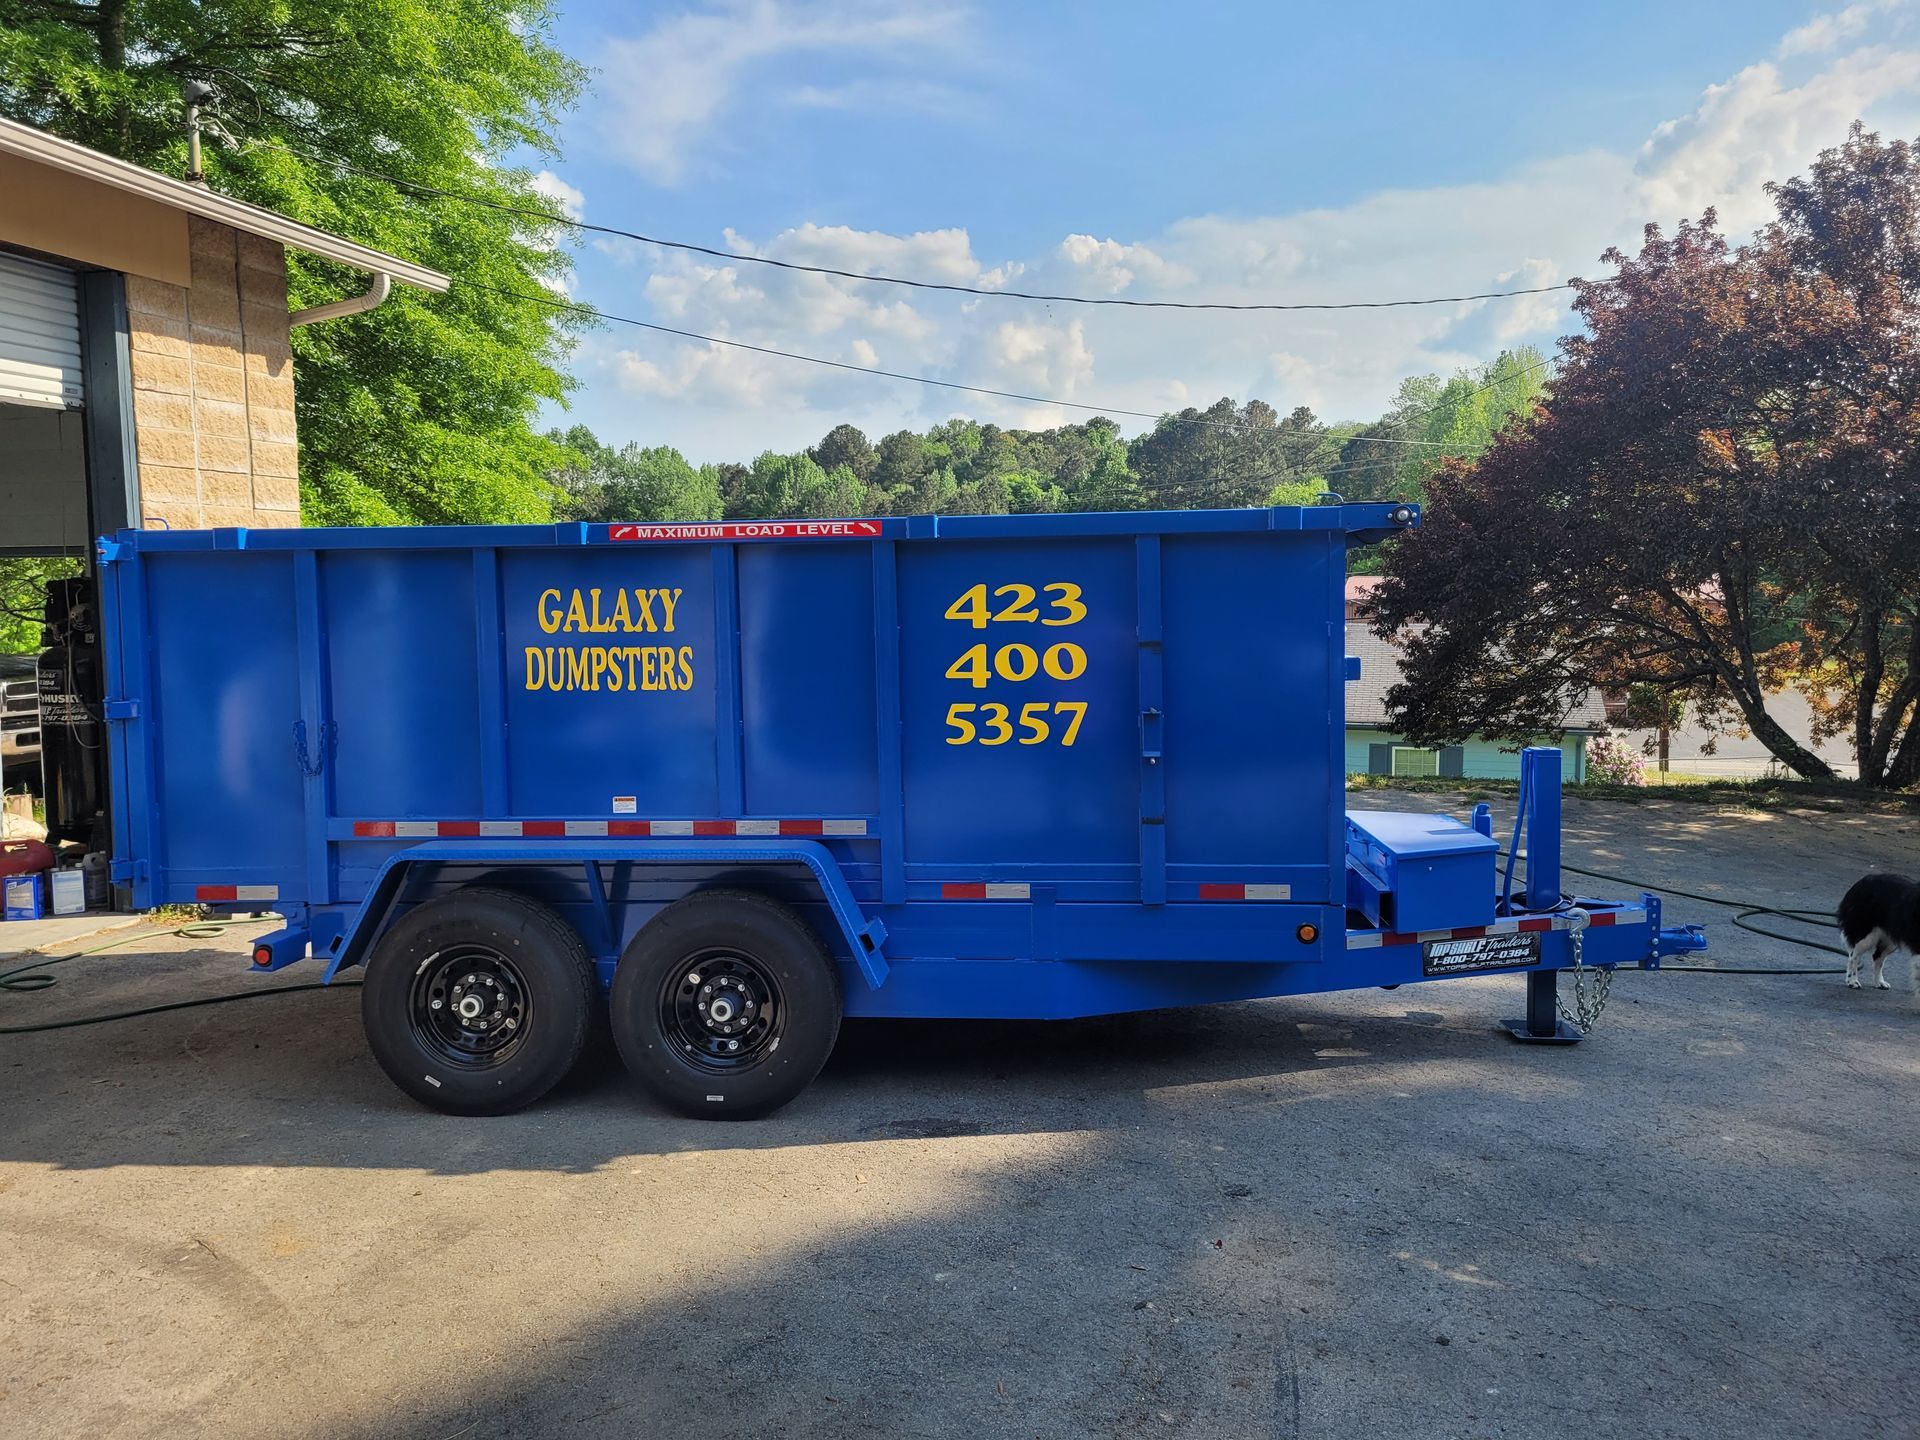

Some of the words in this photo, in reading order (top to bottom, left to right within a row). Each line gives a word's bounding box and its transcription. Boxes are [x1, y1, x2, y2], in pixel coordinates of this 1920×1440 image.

[637, 526, 723, 538] MAXIMUM
[735, 525, 785, 536] LOAD
[796, 524, 854, 535] LEVEL
[537, 588, 682, 634] GALAXY
[944, 582, 1087, 629] 423
[524, 646, 694, 691] DUMPSTERS
[945, 642, 1088, 688] 400
[945, 701, 1088, 746] 5357
[1433, 948, 1530, 965] 1-800-797-0384
[1485, 935, 1533, 952] Trailers
